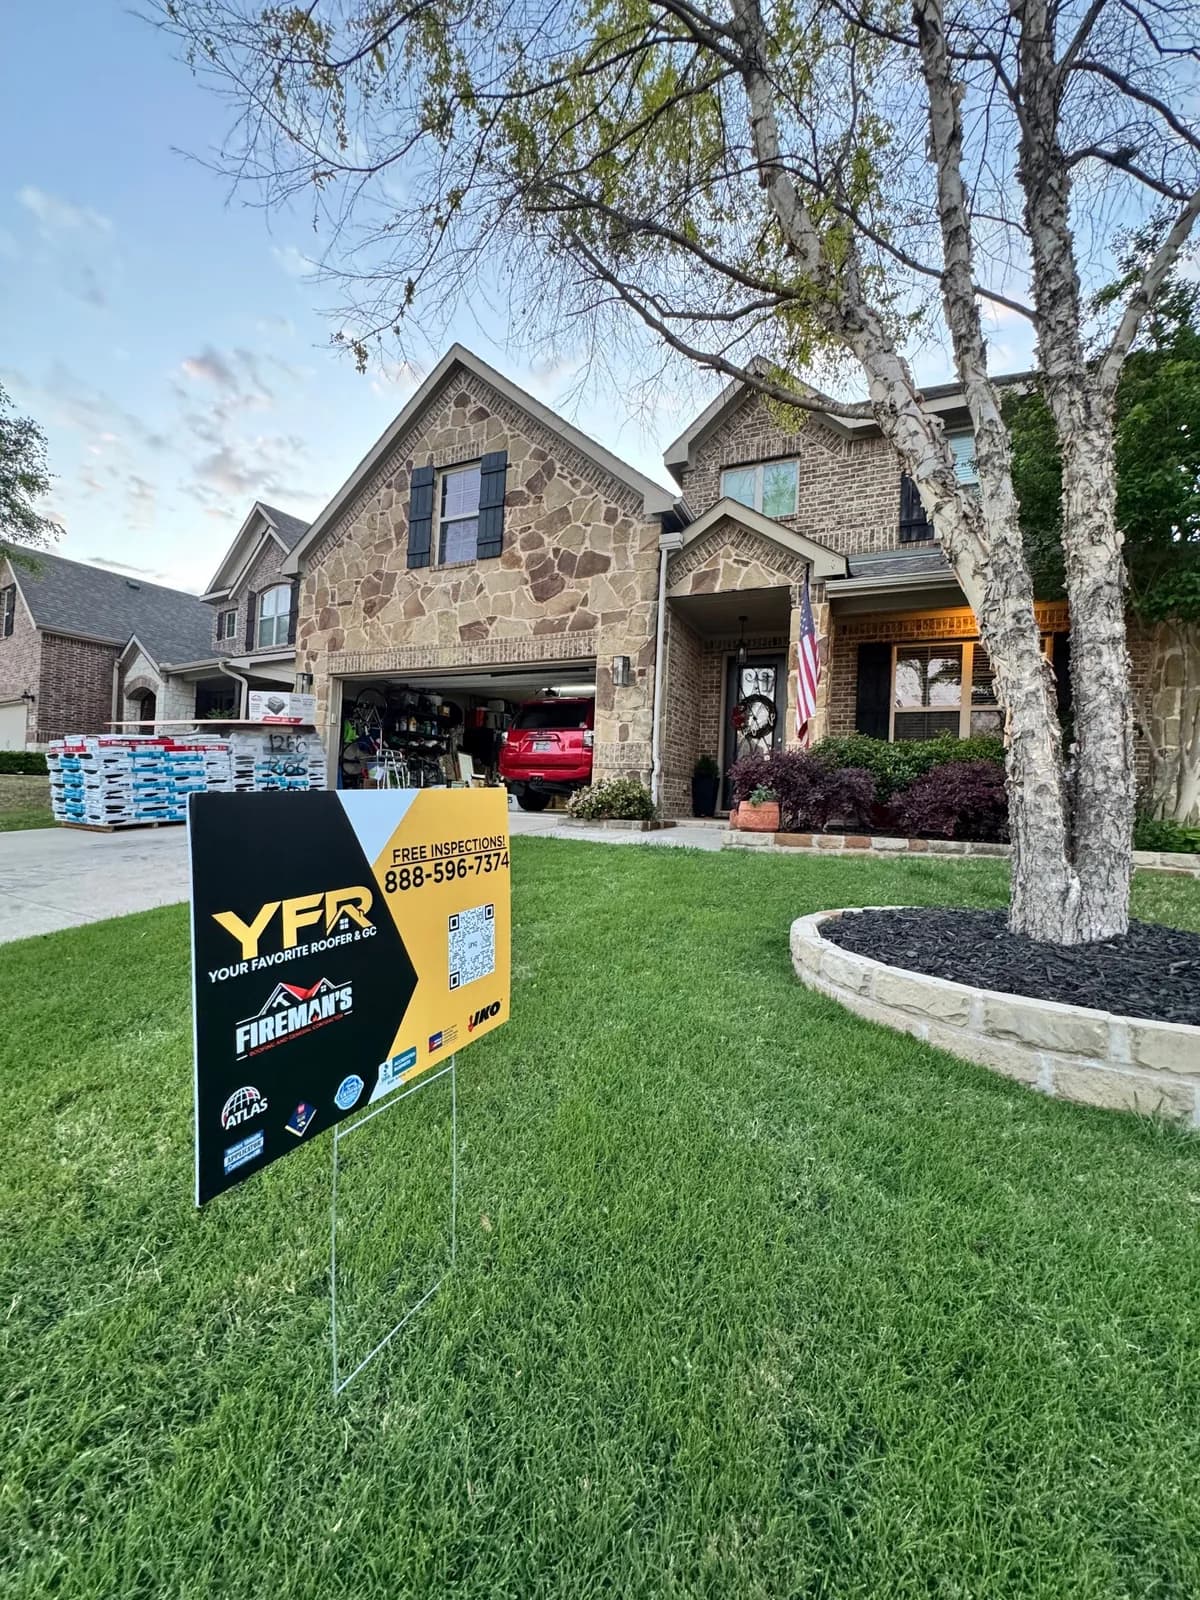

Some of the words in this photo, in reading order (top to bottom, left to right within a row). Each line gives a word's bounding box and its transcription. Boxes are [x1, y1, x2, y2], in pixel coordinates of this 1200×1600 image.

[392, 845, 427, 863] FREE
[431, 835, 505, 857] INSPECTIONS!
[385, 851, 509, 893] 888-596-7374
[211, 885, 374, 960] YFR
[208, 961, 249, 983] YOUR
[251, 945, 309, 971] FAVORITE
[311, 933, 353, 954] ROOFER
[354, 930, 361, 941] &
[362, 926, 377, 938] GC
[236, 986, 352, 1054] FIREMAN'S
[473, 1001, 501, 1027] IKO
[225, 1097, 268, 1130] ATLAS
